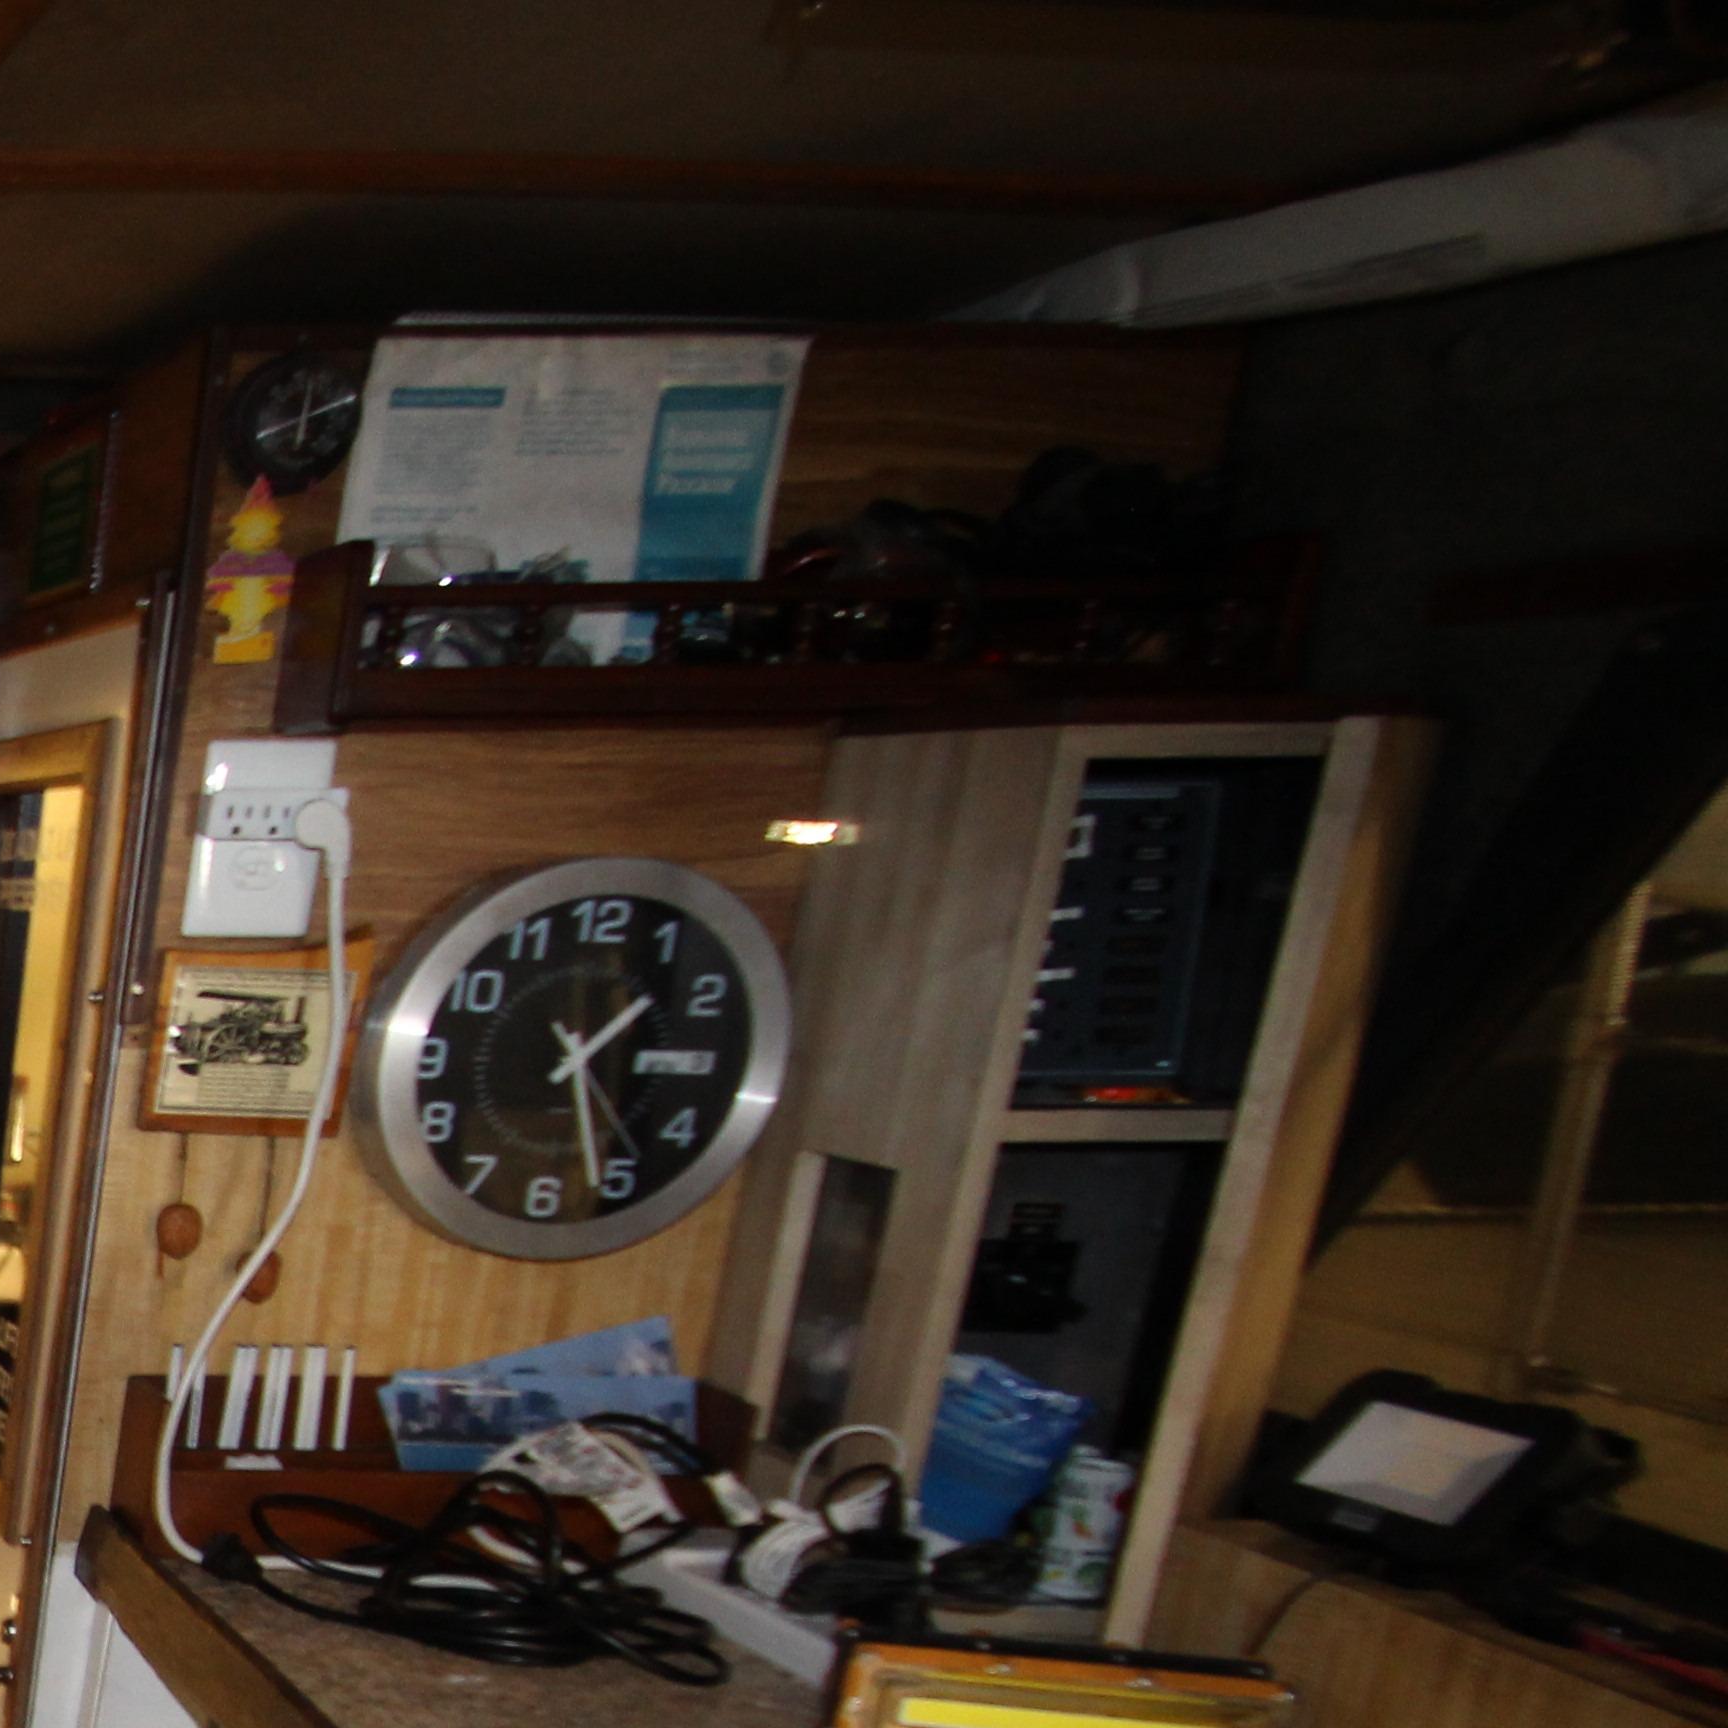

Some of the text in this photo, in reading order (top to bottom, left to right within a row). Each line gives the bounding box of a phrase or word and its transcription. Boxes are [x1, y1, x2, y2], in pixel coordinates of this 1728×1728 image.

[507, 917, 552, 961] 11
[571, 899, 634, 943] 12
[653, 920, 680, 965] 1
[449, 968, 504, 1014] 10
[686, 973, 729, 1018] 2
[416, 1036, 449, 1080] 9
[420, 1100, 456, 1143] 8
[658, 1106, 697, 1148] 4
[463, 1154, 499, 1195] 7
[523, 1175, 563, 1218] 6
[600, 1157, 638, 1200] 5
